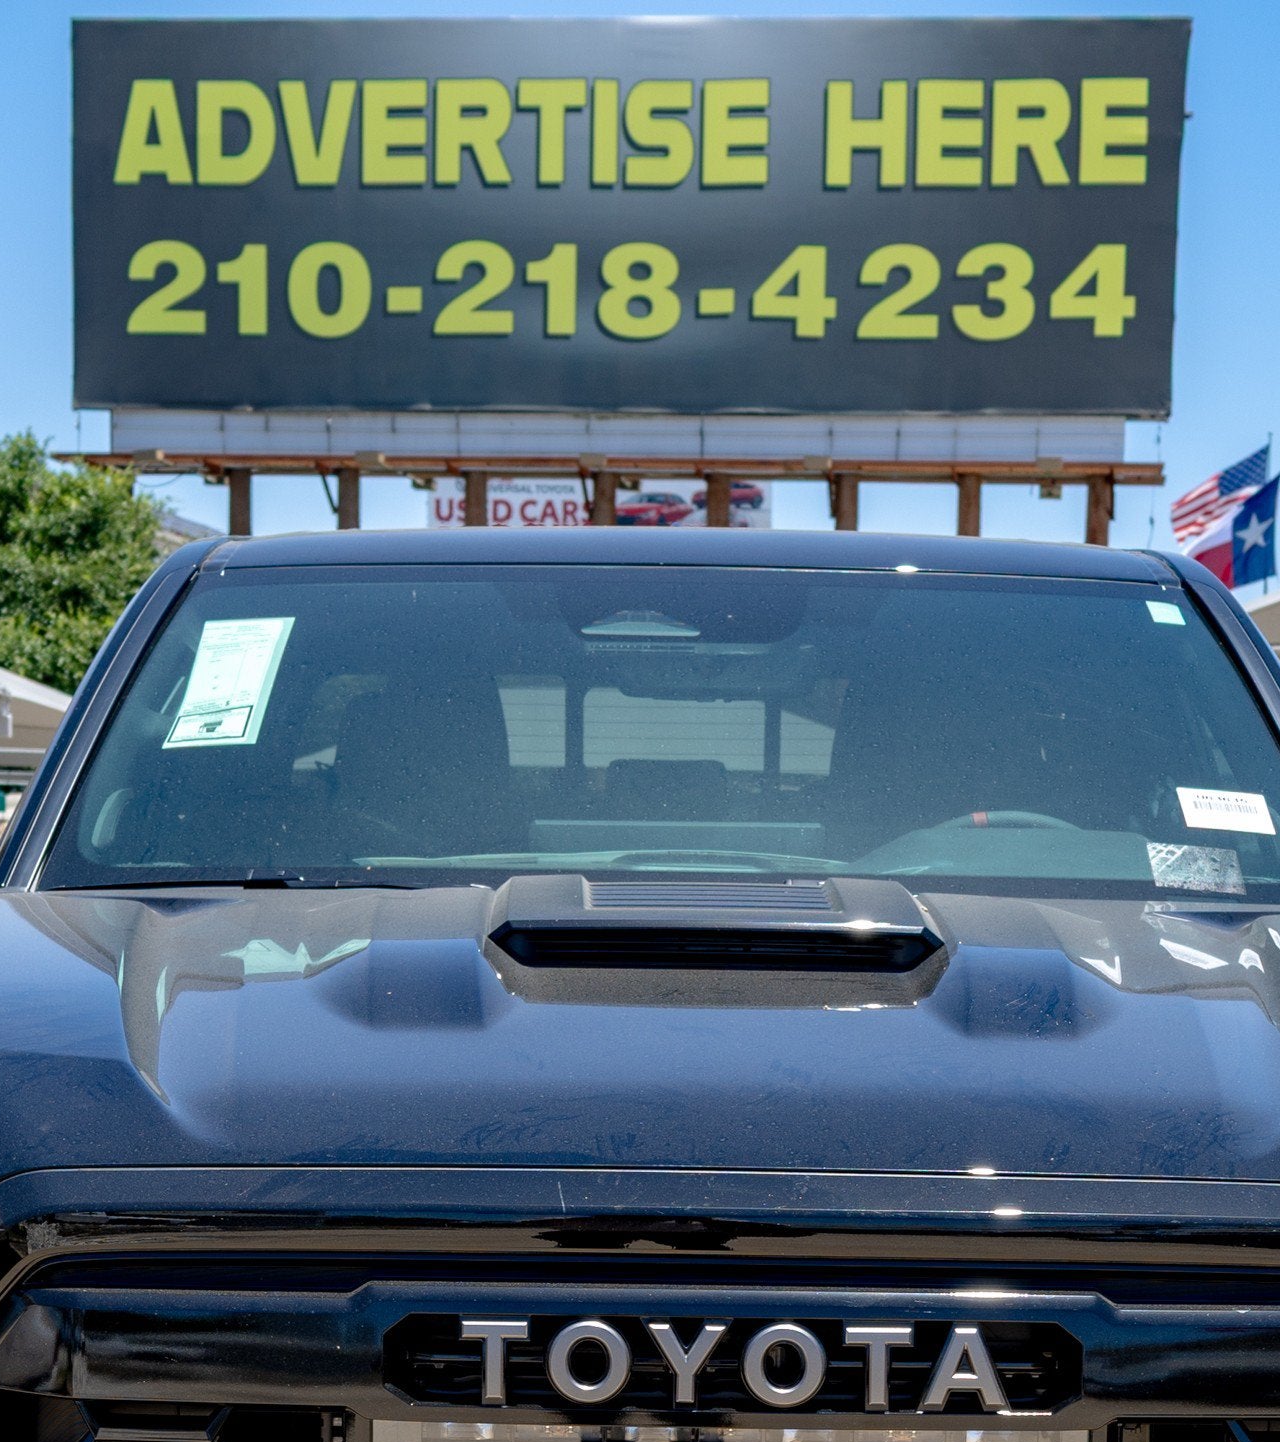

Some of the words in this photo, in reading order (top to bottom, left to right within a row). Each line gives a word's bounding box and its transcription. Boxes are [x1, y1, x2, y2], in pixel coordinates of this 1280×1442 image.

[114, 77, 770, 187] ADVERTISE
[824, 77, 1150, 188] HERE
[127, 240, 1137, 341] 210-218-4234
[434, 498, 512, 523] USD
[458, 1316, 1010, 1411] TOYOTA
